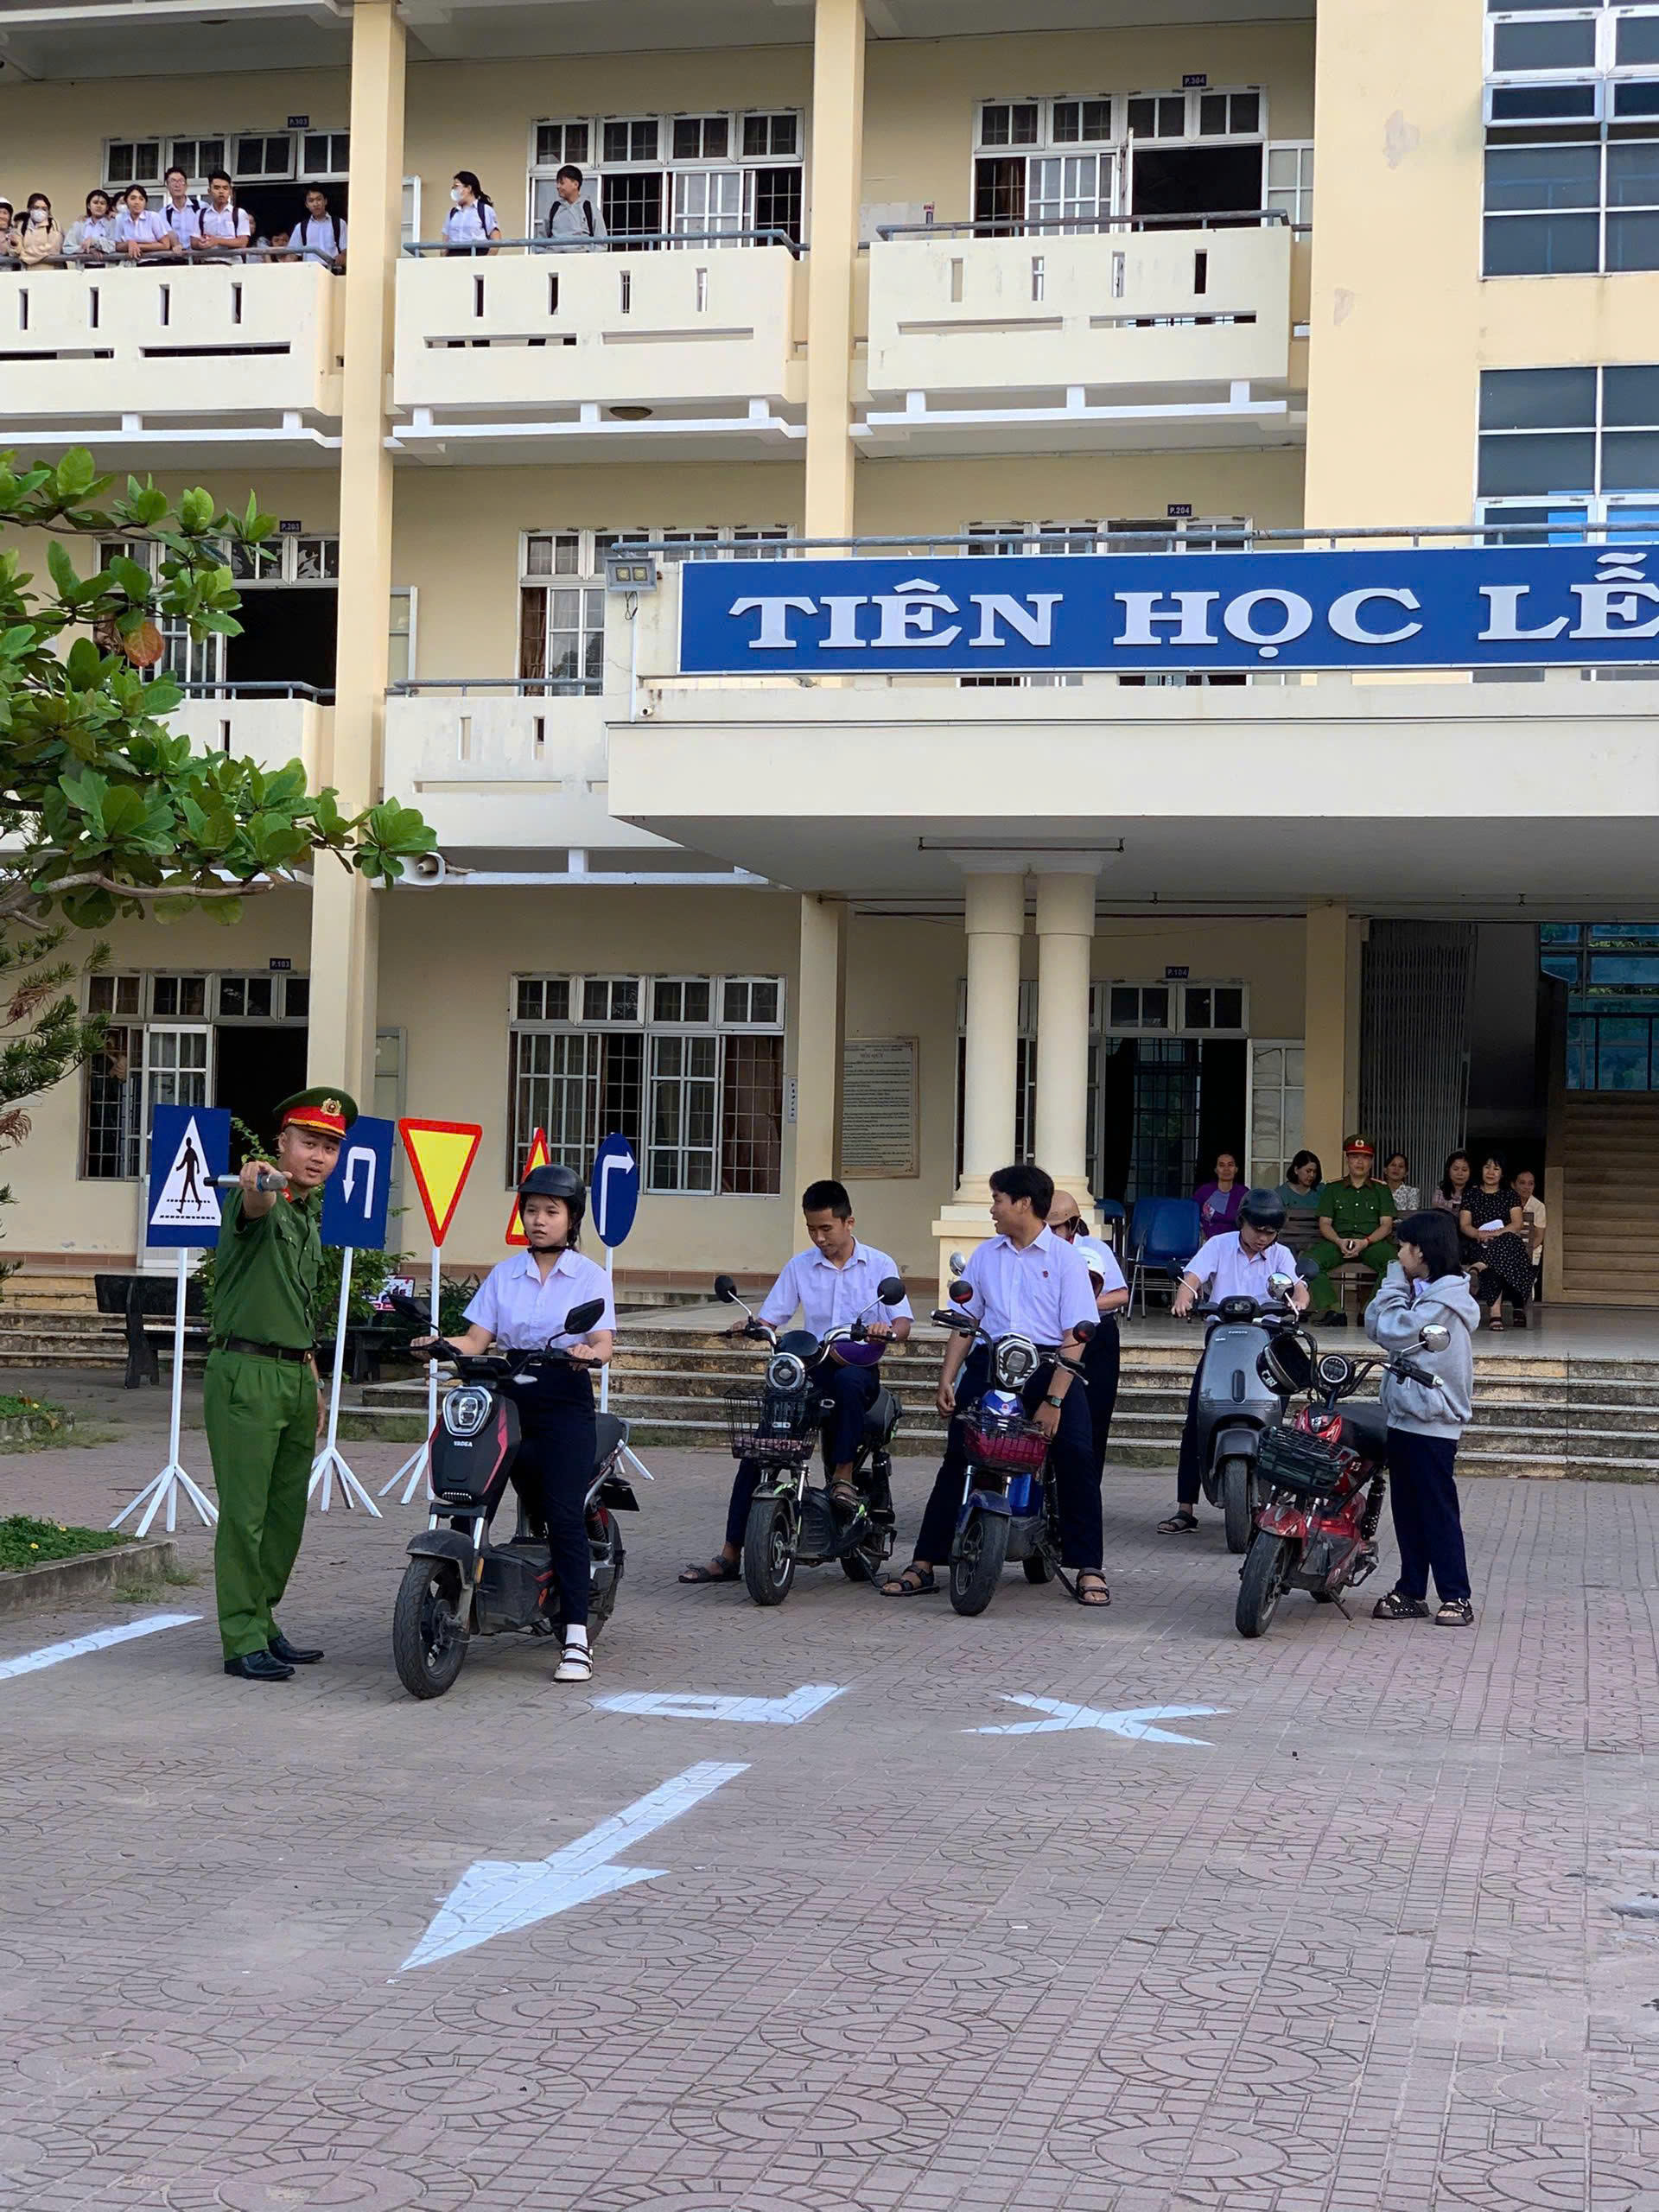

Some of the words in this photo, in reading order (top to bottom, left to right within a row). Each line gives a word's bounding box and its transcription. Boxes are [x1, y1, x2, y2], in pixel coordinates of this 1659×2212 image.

[1185, 76, 1205, 85] P.304
[728, 578, 1064, 648] TIÊN
[1113, 588, 1423, 658] HỌC
[1478, 552, 1659, 640] LỄ
